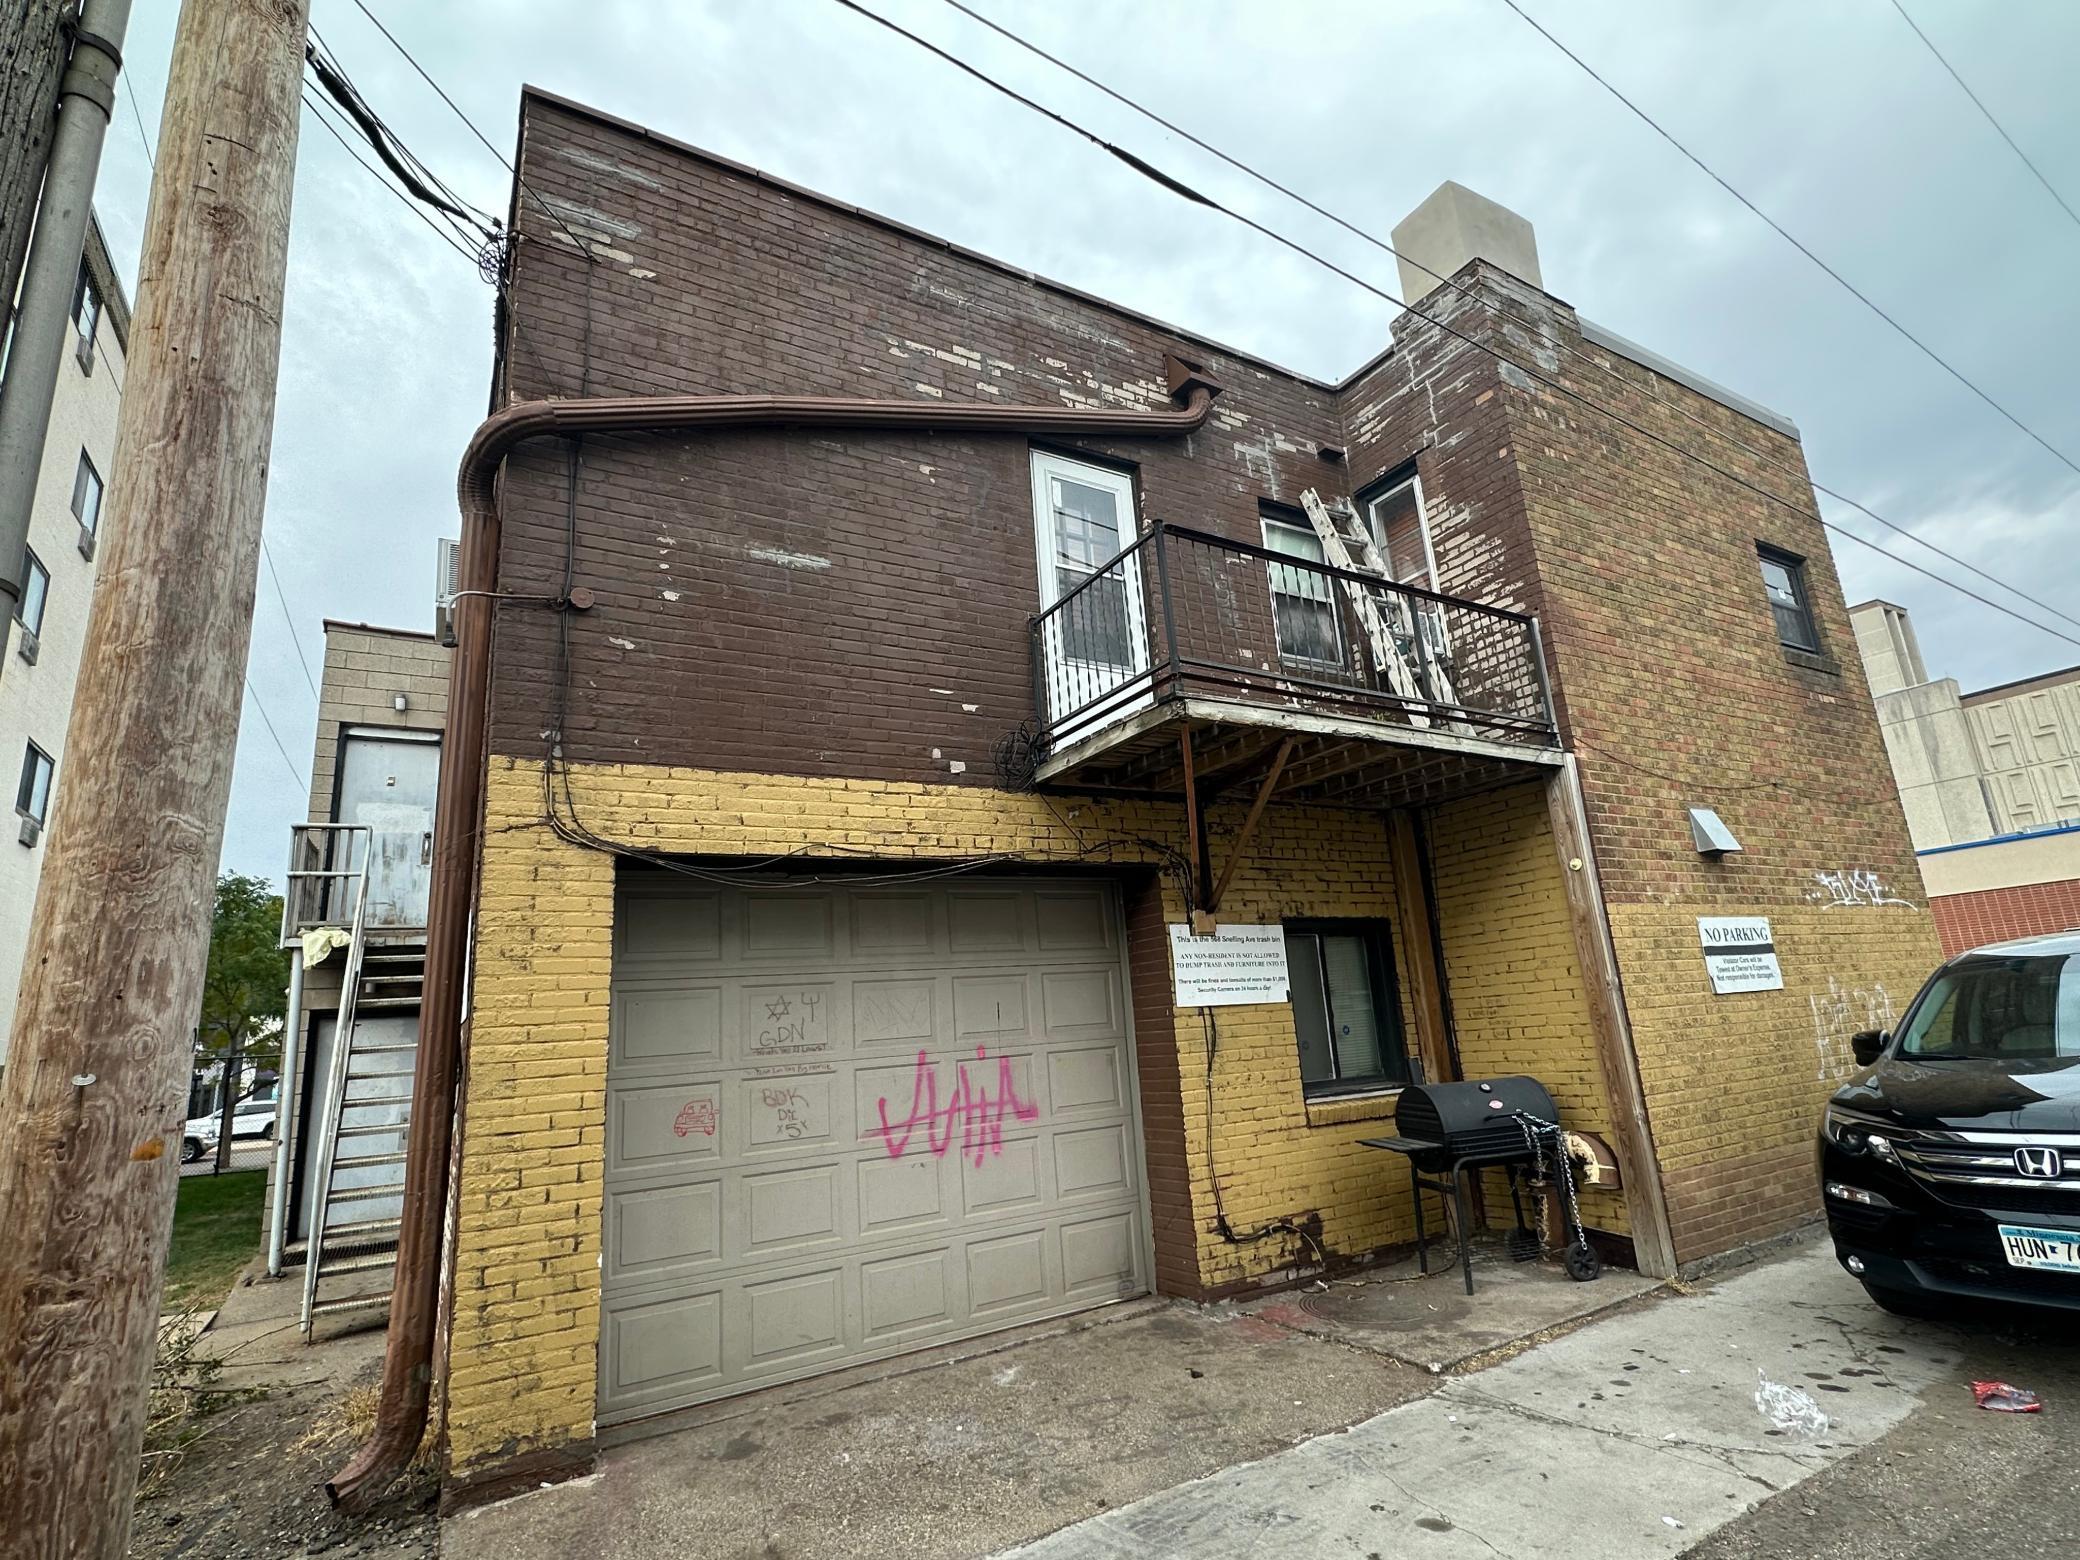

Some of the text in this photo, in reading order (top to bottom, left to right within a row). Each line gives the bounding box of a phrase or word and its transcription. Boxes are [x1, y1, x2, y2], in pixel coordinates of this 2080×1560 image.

[1199, 935, 1209, 943] the
[1222, 935, 1245, 944] Snelling
[1245, 935, 1256, 943] Ave
[1256, 935, 1270, 943] trash
[1271, 935, 1281, 943] bin
[1704, 927, 1769, 942] NO PARKING
[1716, 965, 1731, 973] Towed
[2007, 1236, 2048, 1260] HUN
